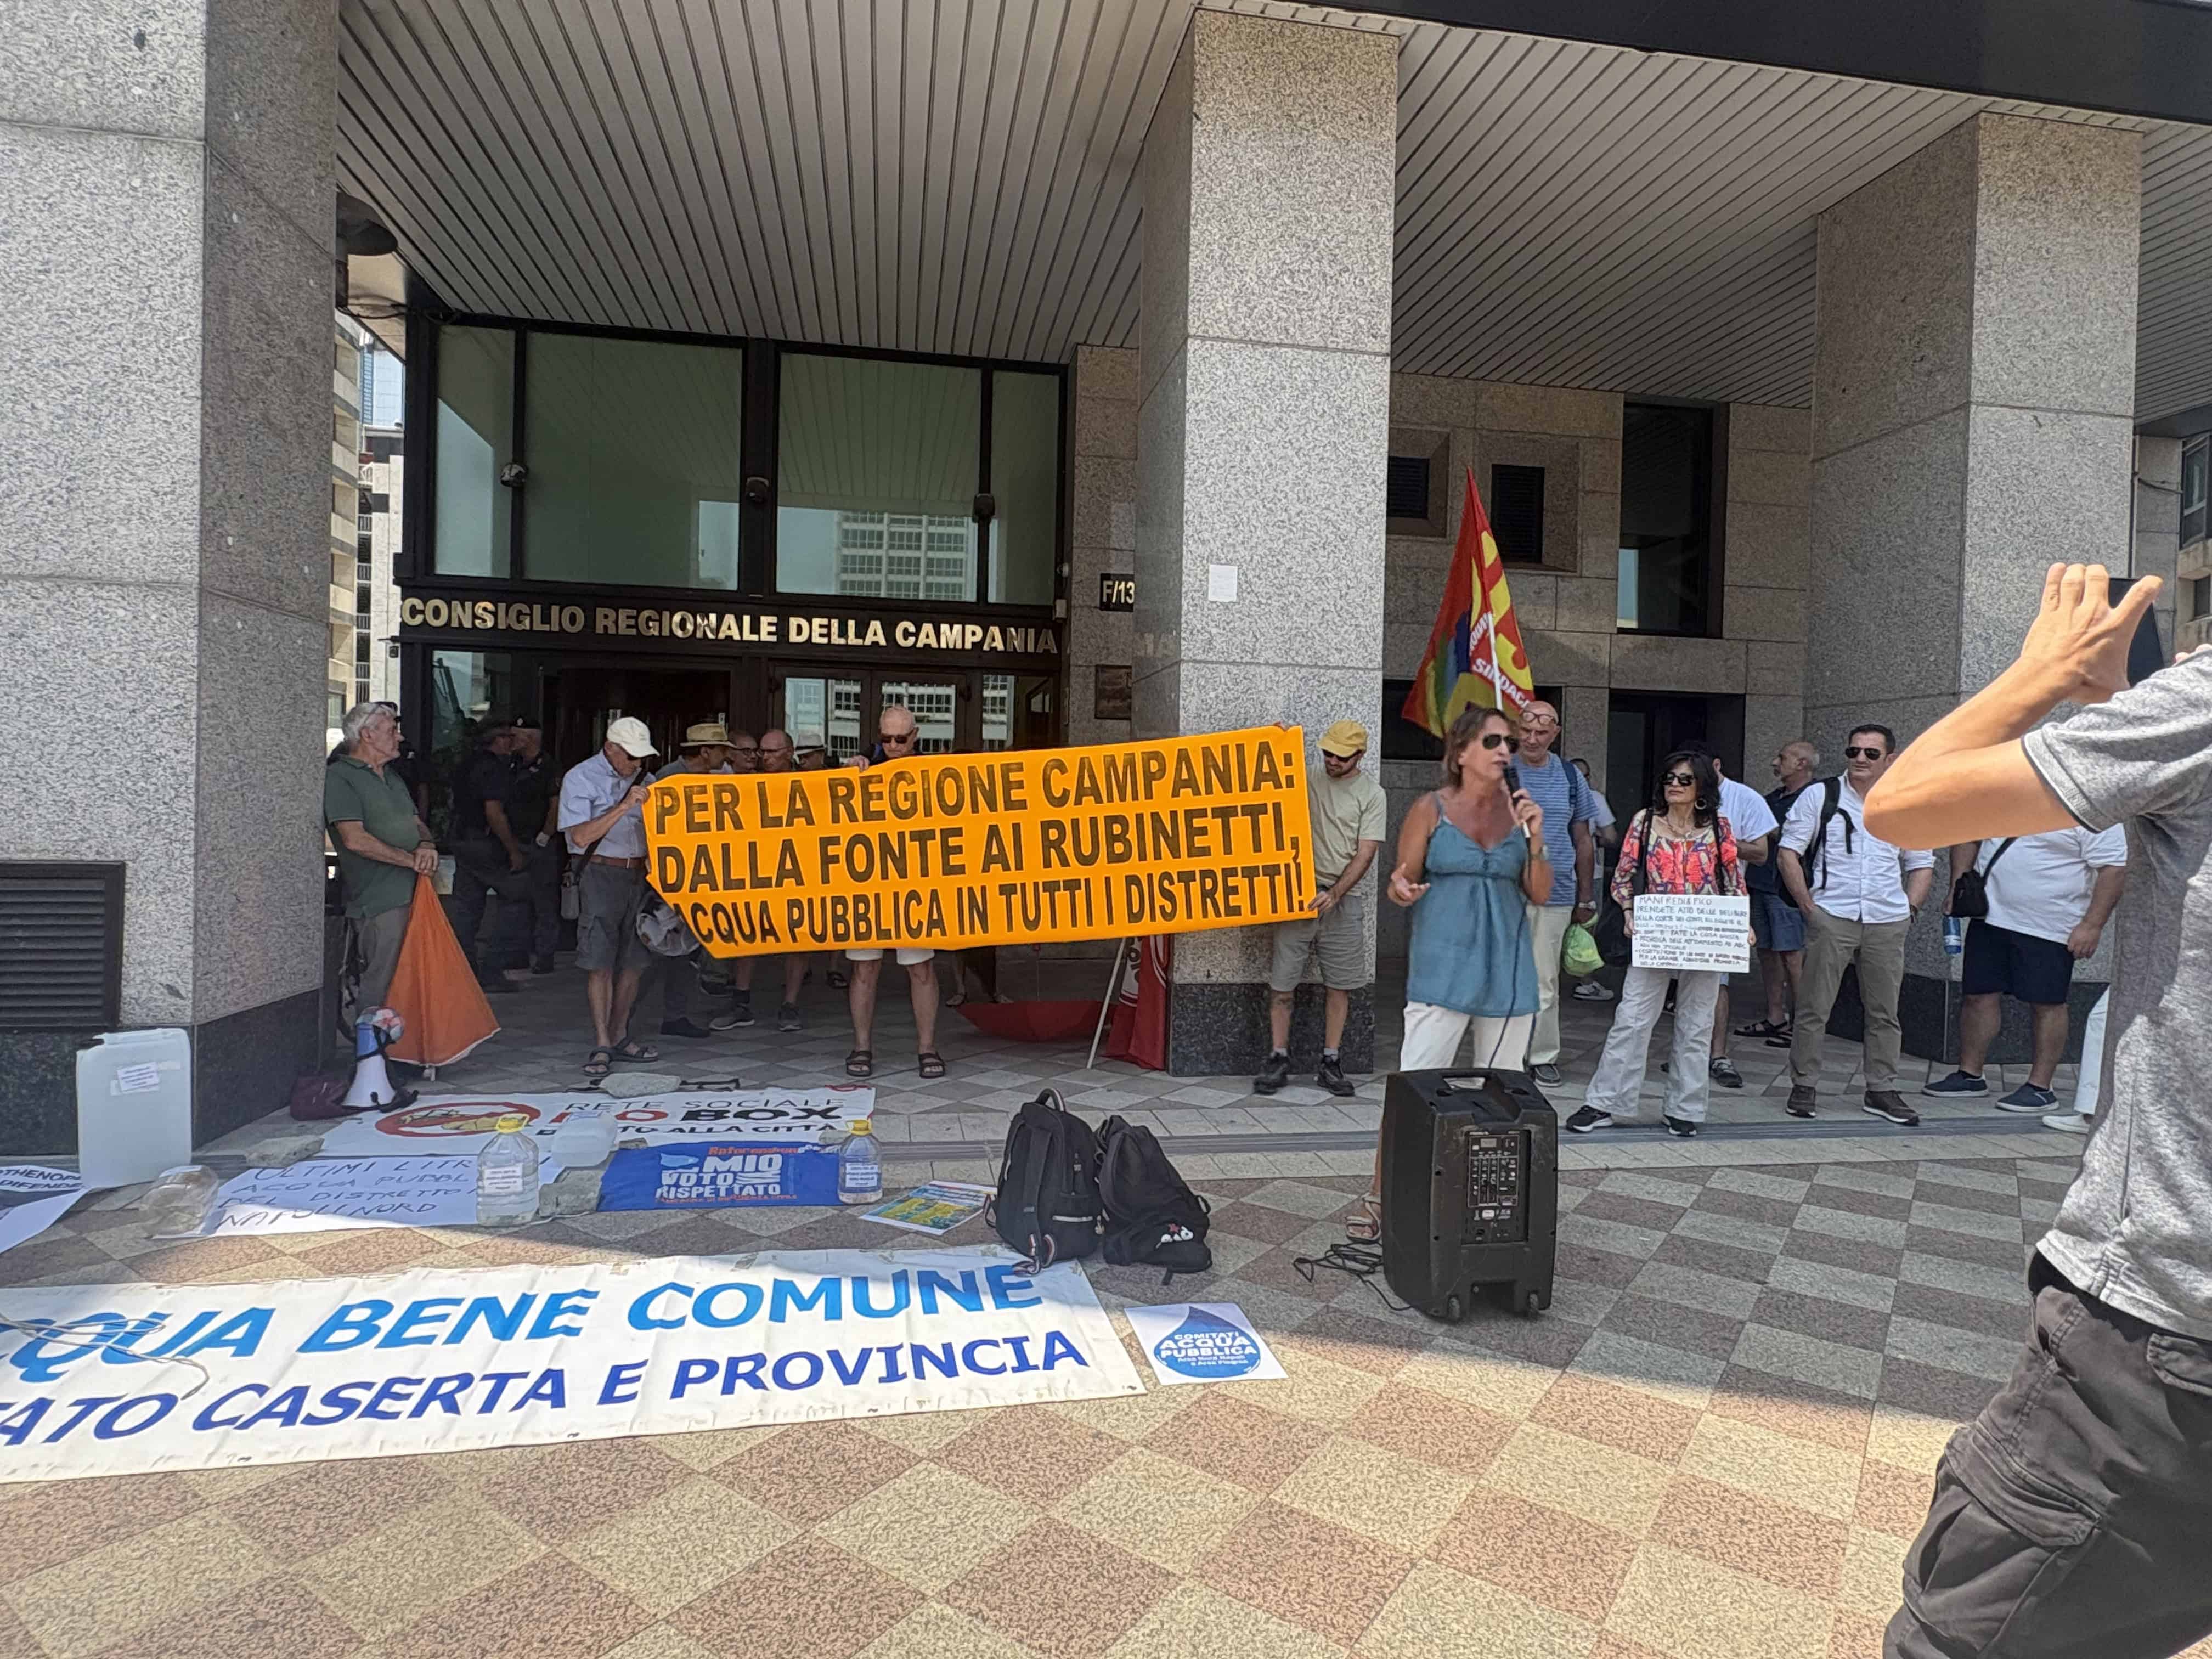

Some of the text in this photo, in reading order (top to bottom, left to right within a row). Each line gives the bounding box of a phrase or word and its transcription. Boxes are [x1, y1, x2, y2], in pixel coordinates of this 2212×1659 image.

[401, 597, 1058, 653] CONSIGLIO REGIONALE DELLA CAMPANIA
[654, 741, 1295, 834] PER LA REGIONE CAMPANIA:
[657, 802, 1300, 893] DALLA FONTE AI RUBINETTI,
[786, 889, 948, 943] PUBBLICA
[956, 885, 989, 936] IN
[998, 877, 1093, 932] TUTTI
[1105, 876, 1114, 926] I
[1125, 862, 1305, 924] DISTRETTI!
[565, 1098, 847, 1111] RETE SOCIALE
[679, 1106, 843, 1121] BOX
[664, 1125, 744, 1134] ALLA
[254, 1159, 473, 1180] ULTIMI LITR
[702, 1154, 783, 1173] MIO
[231, 1179, 356, 1194] ACQUA
[661, 1172, 735, 1186] VOTO
[655, 1183, 782, 1199] RISPETTATO
[218, 1195, 276, 1208] DEL
[214, 1203, 437, 1229] NAPOLI NORD
[296, 1288, 601, 1353] BENE
[628, 1264, 1043, 1330] COMUNE
[1159, 1336, 1251, 1350] ACQUA
[1173, 1331, 1239, 1340] COMITATI
[1160, 1345, 1258, 1359] PUBBLICA
[0, 1330, 1090, 1446] ATO CASERTA E PROVINCIA
